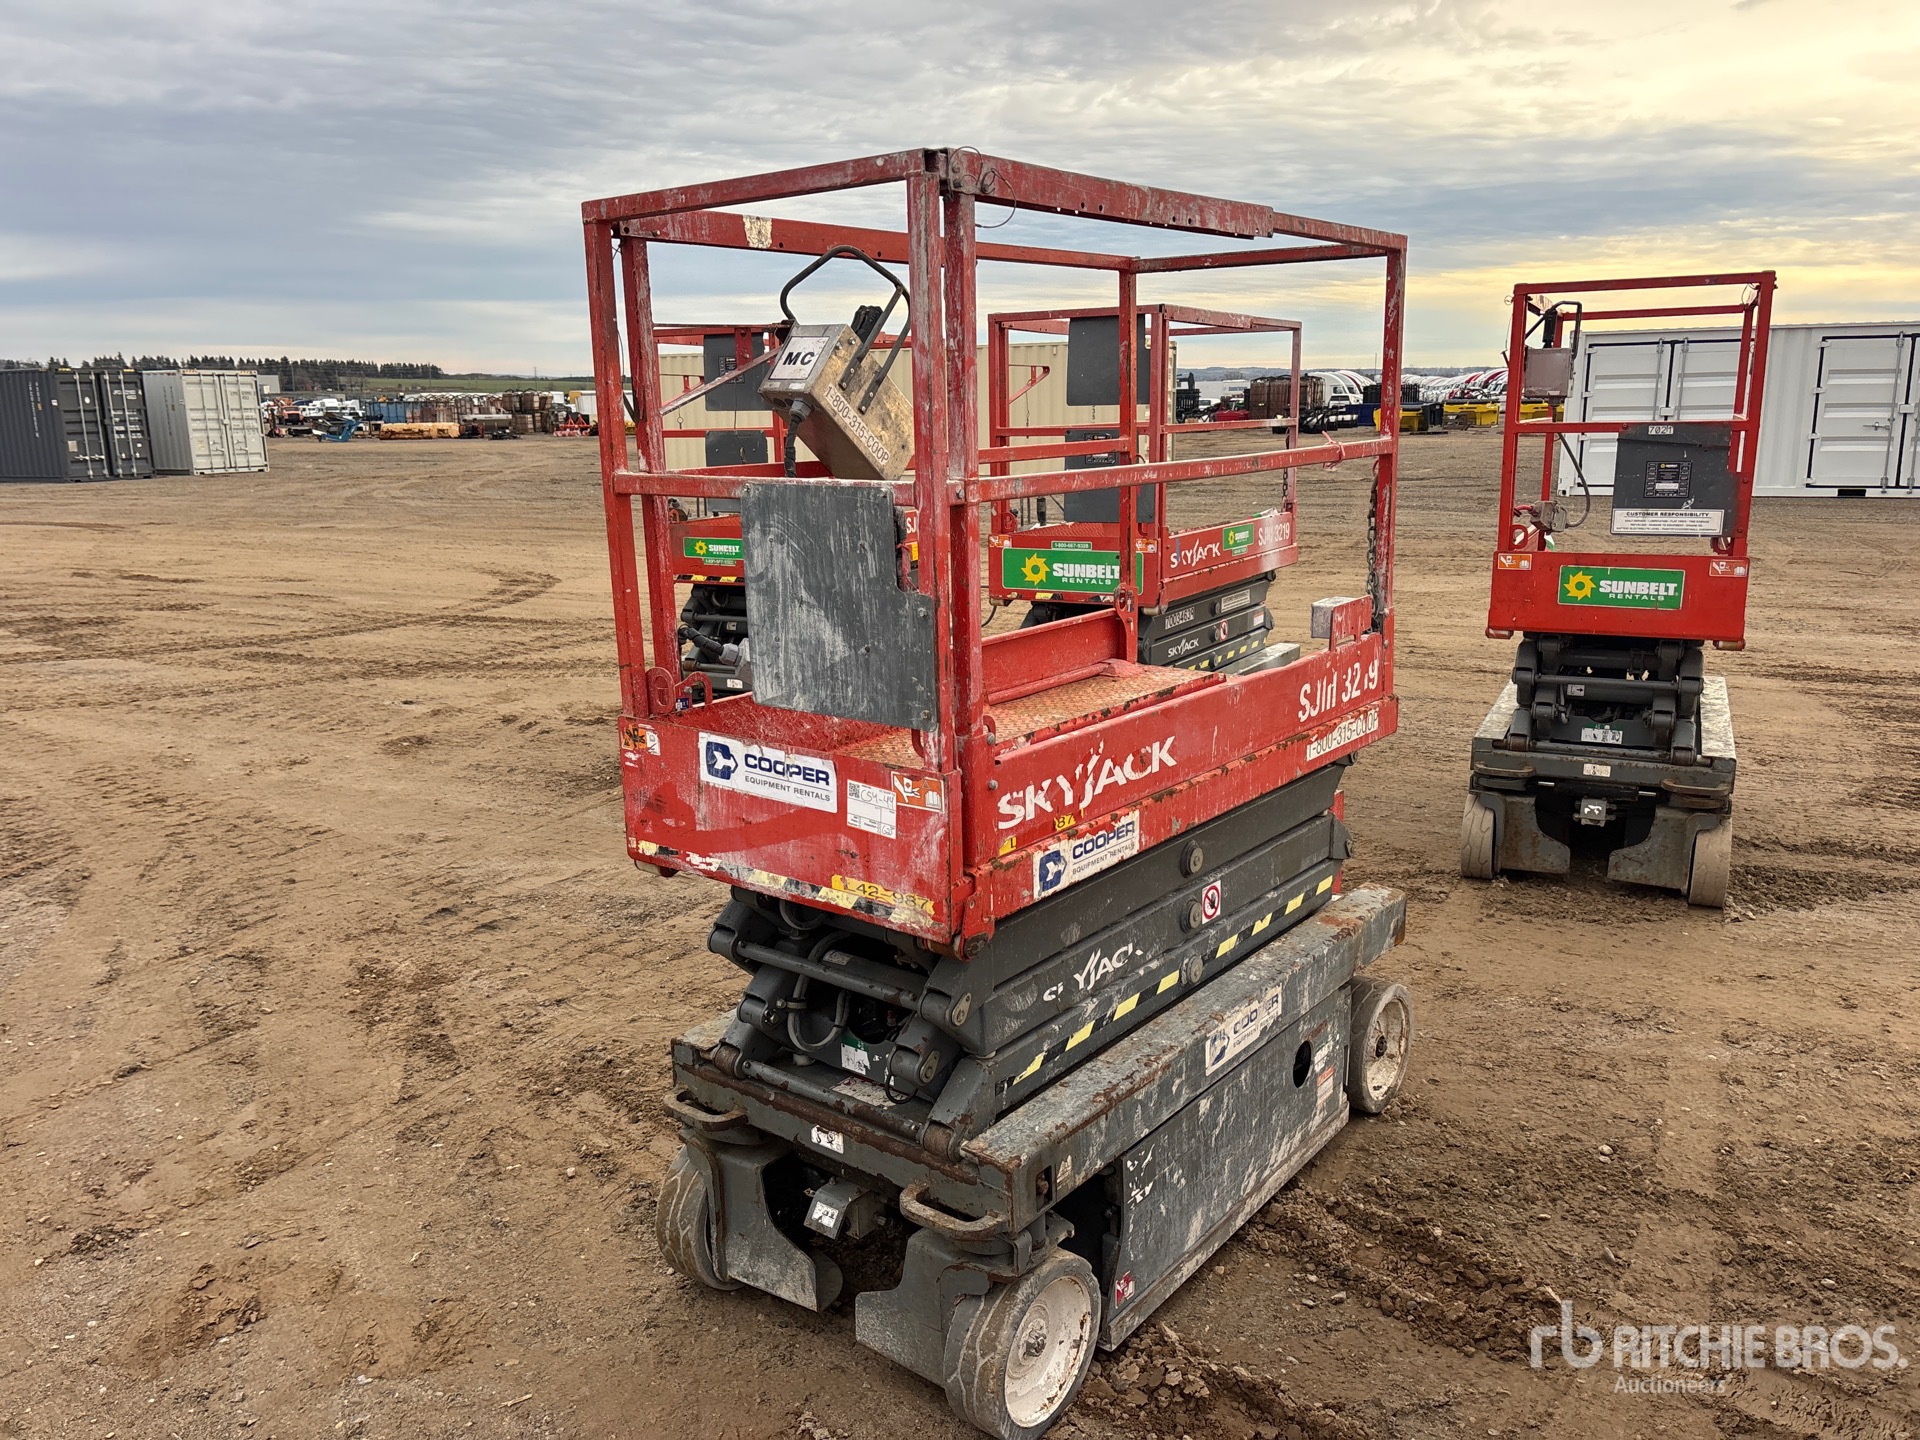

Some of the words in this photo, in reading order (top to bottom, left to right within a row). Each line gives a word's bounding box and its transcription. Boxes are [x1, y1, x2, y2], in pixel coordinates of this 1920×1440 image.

[782, 351, 815, 366] MC
[825, 385, 890, 463] 1-800-315-COOP
[708, 544, 740, 553] SUNBELT
[1052, 562, 1120, 579] SUNBELT
[1061, 577, 1112, 586] RENTALS
[1598, 579, 1678, 596] SUNBELT
[1608, 593, 1665, 602] RENTALS
[1167, 638, 1200, 658] SKYJACK
[744, 753, 830, 786] COOPER
[744, 775, 791, 793] EQUIPMENT
[793, 787, 831, 802] RENTALS
[997, 736, 1178, 829] SKYJACK
[1072, 820, 1136, 860] COOPER
[1072, 854, 1108, 875] EQUIPMENT
